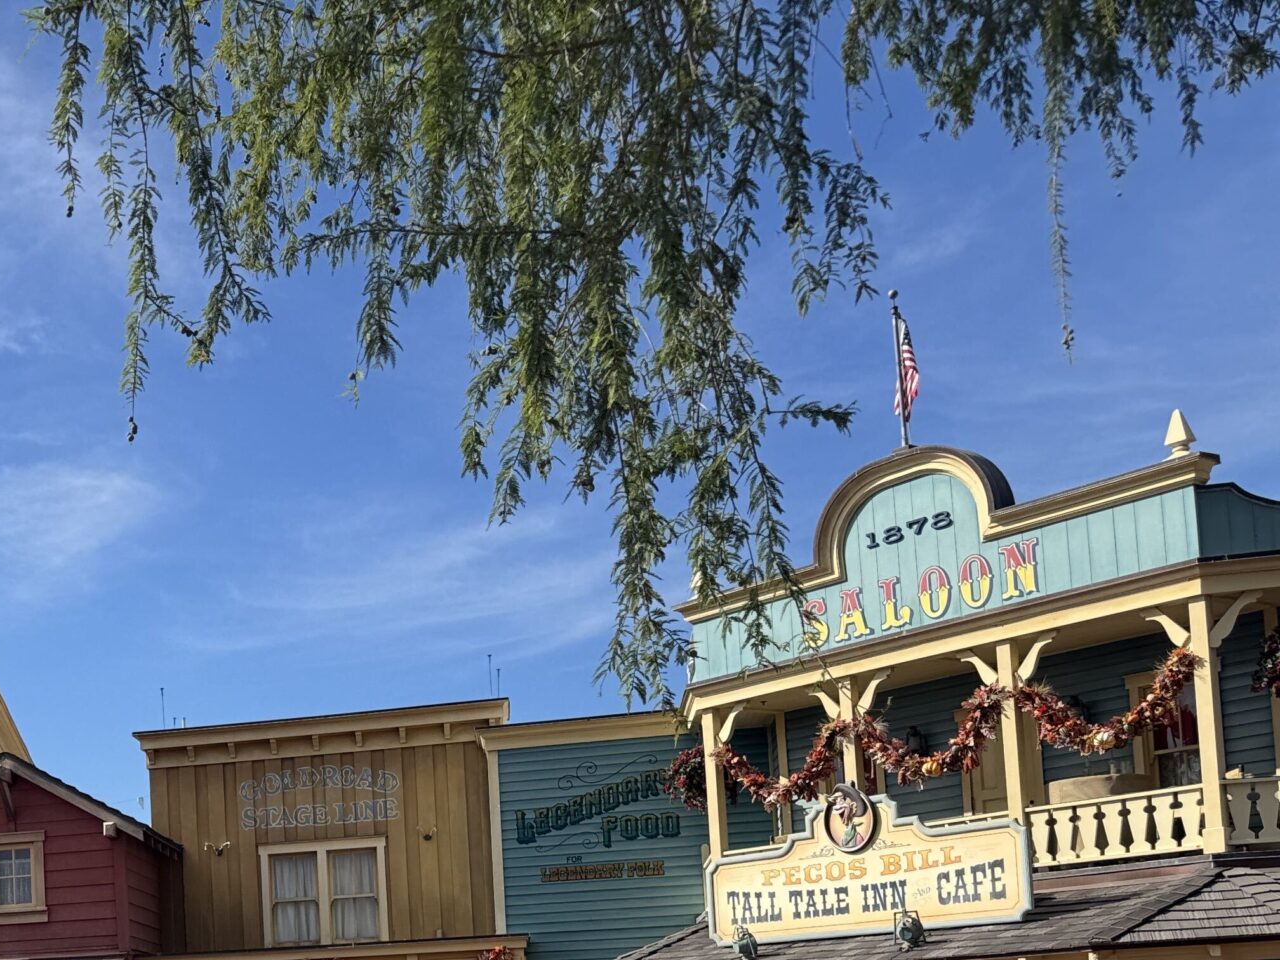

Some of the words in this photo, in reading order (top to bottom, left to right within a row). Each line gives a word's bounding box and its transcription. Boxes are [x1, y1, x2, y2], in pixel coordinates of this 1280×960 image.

[865, 510, 954, 549] 1878
[801, 537, 1039, 649] SALOON
[240, 804, 330, 830] STAGE
[333, 797, 400, 824] LINE
[600, 811, 681, 848] FOOD
[540, 862, 625, 883] LEGENDARY
[626, 860, 665, 878] FOLK
[566, 855, 583, 864] FOR
[761, 857, 867, 886] PECOS
[880, 845, 962, 876] BILL
[727, 890, 782, 926] TALL
[789, 886, 850, 920] TALE
[861, 879, 907, 913] INN
[937, 858, 1007, 906] CAFE
